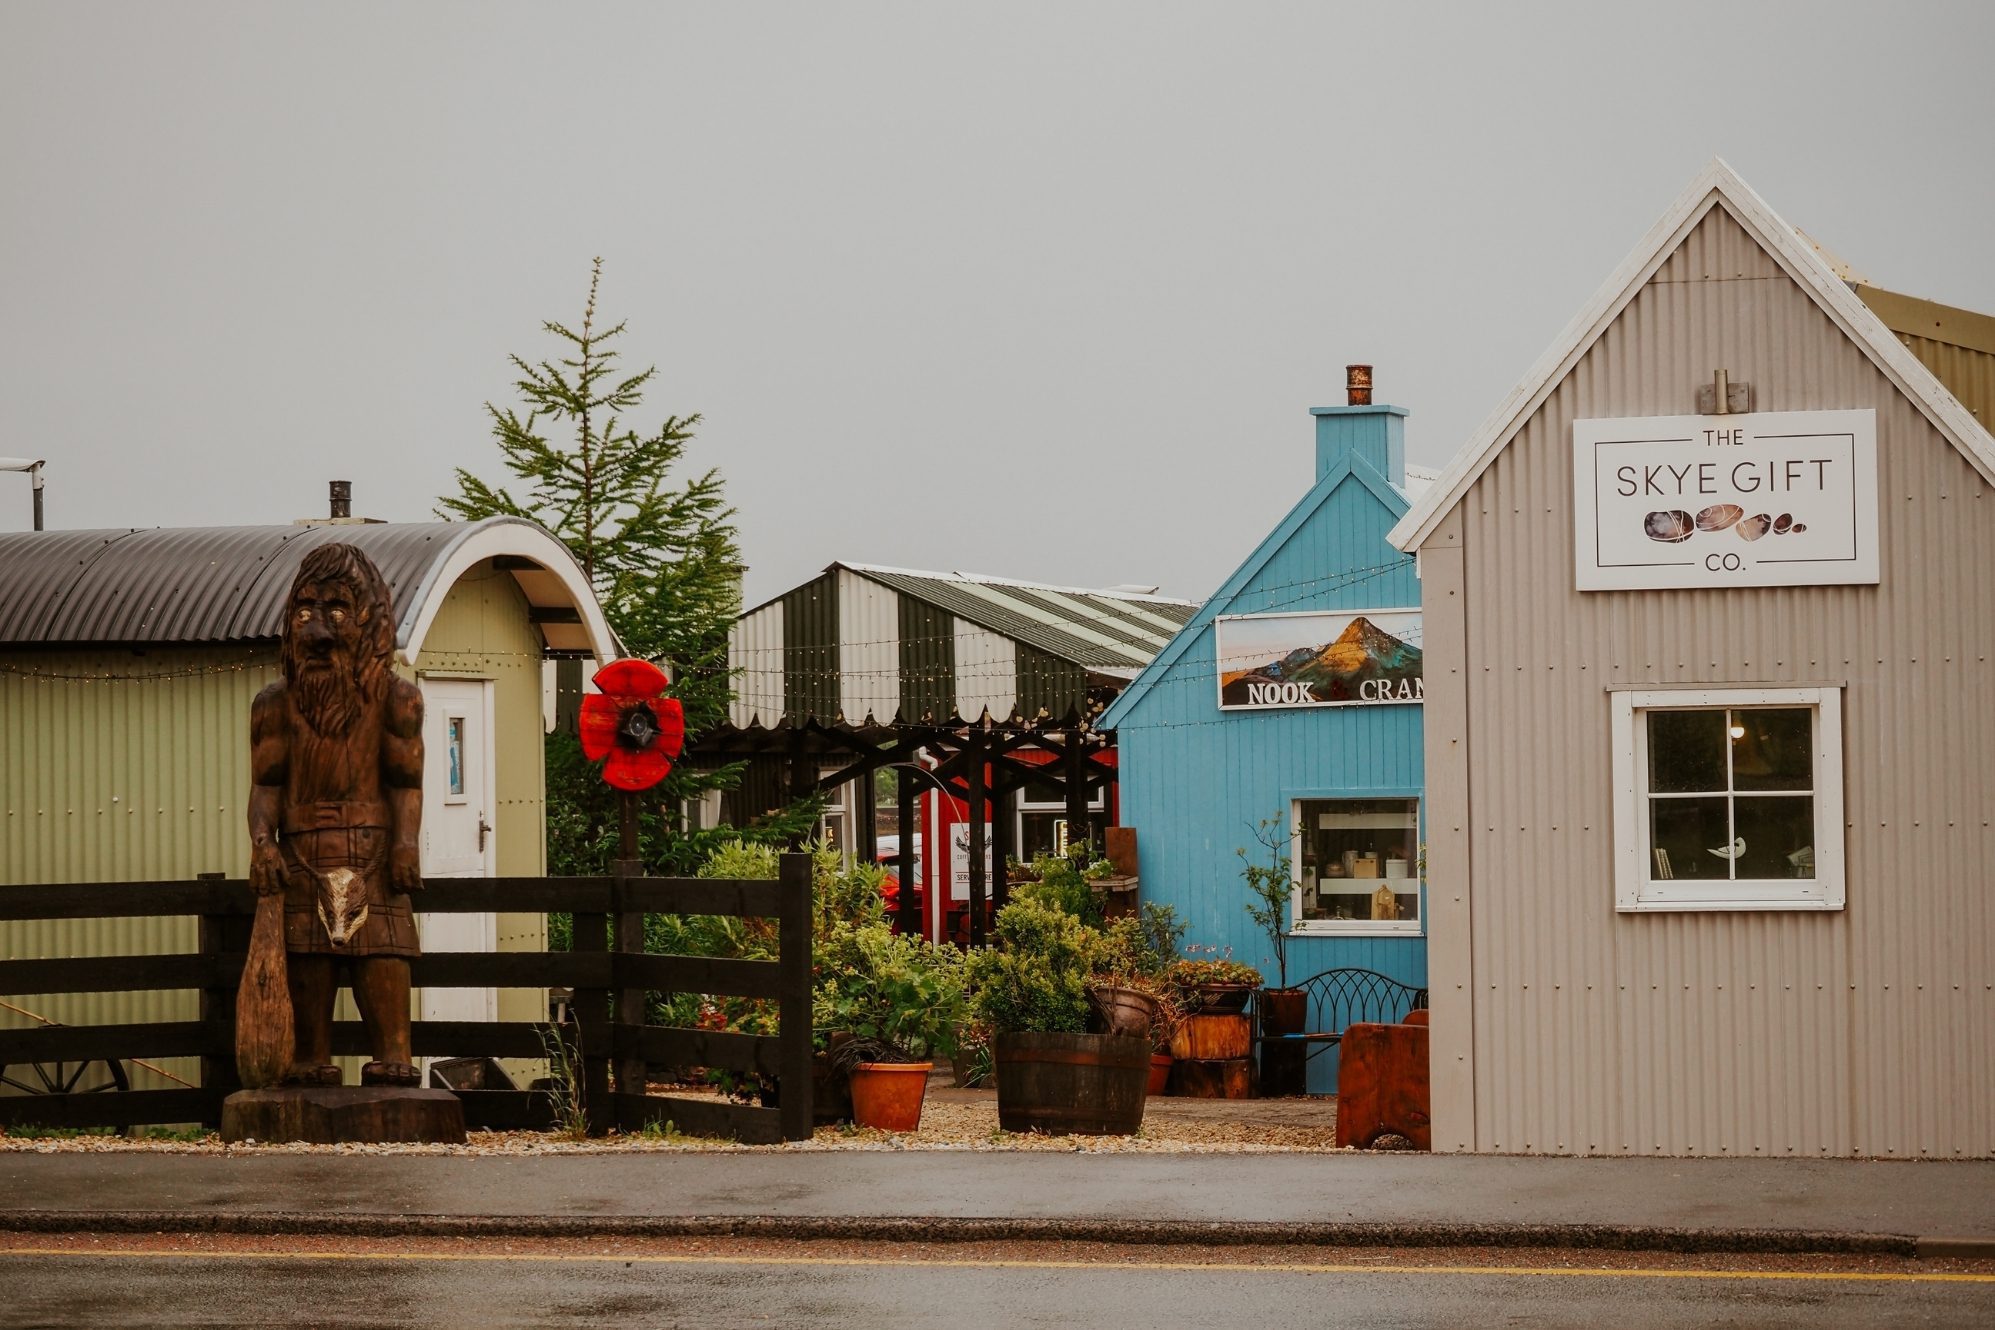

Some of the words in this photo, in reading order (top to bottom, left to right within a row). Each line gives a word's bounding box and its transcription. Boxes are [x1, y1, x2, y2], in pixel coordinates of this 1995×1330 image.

[1703, 429, 1744, 446] THE
[1617, 464, 1717, 496] SKYE
[1731, 459, 1832, 493] GIFT
[1705, 553, 1746, 571] CO.
[1247, 682, 1316, 705] NOOK
